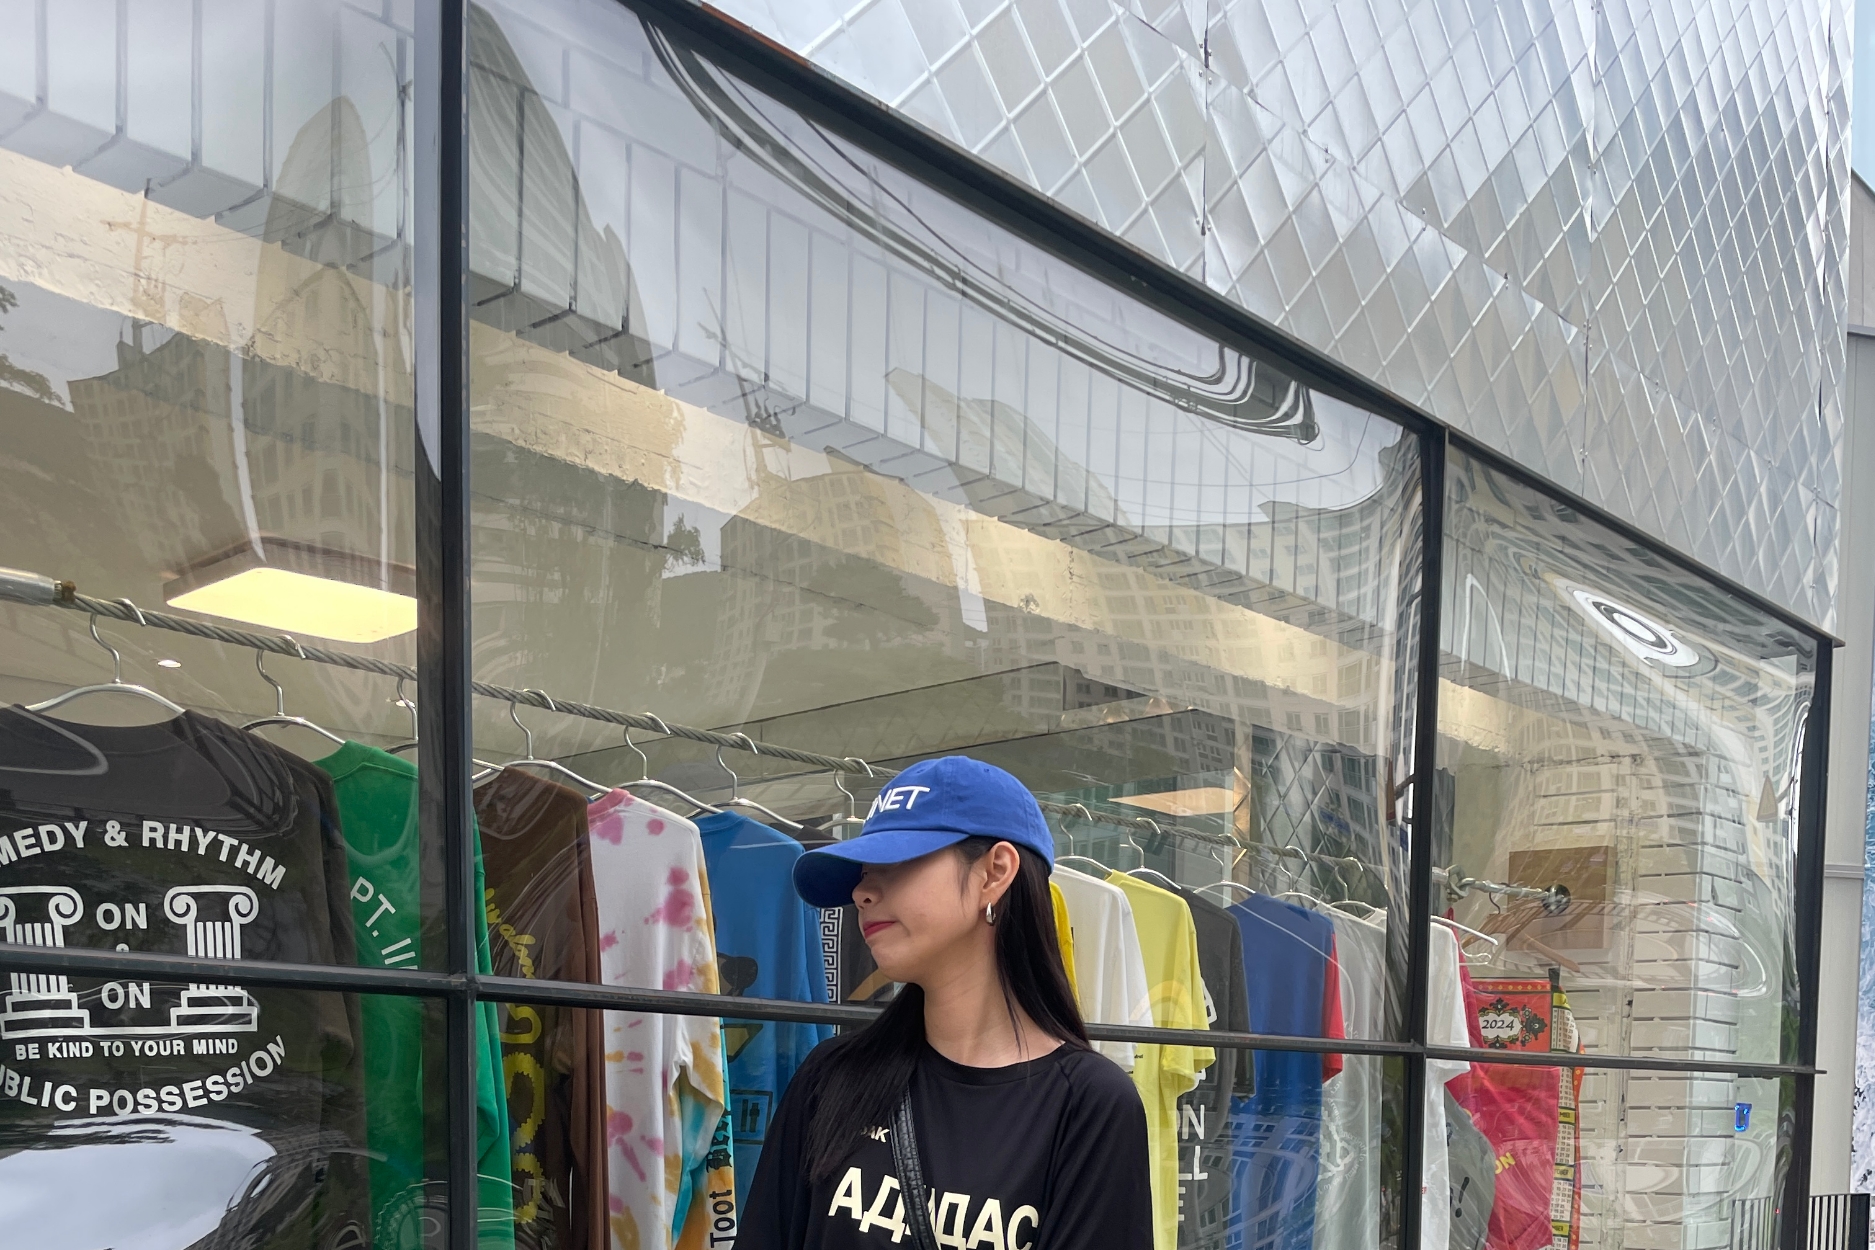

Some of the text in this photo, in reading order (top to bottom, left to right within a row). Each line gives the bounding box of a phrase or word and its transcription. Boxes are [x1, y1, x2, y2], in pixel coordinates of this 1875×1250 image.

[103, 820, 129, 847] &
[142, 820, 287, 890] RHYTHM
[96, 902, 148, 931] ON
[101, 982, 151, 1010] ON
[1481, 1018, 1515, 1031] 2024
[15, 1038, 239, 1061] BE KIND TO YOUR MIND
[0, 1035, 287, 1116] BLIC POSSESSION
[709, 1189, 737, 1249] Toot
